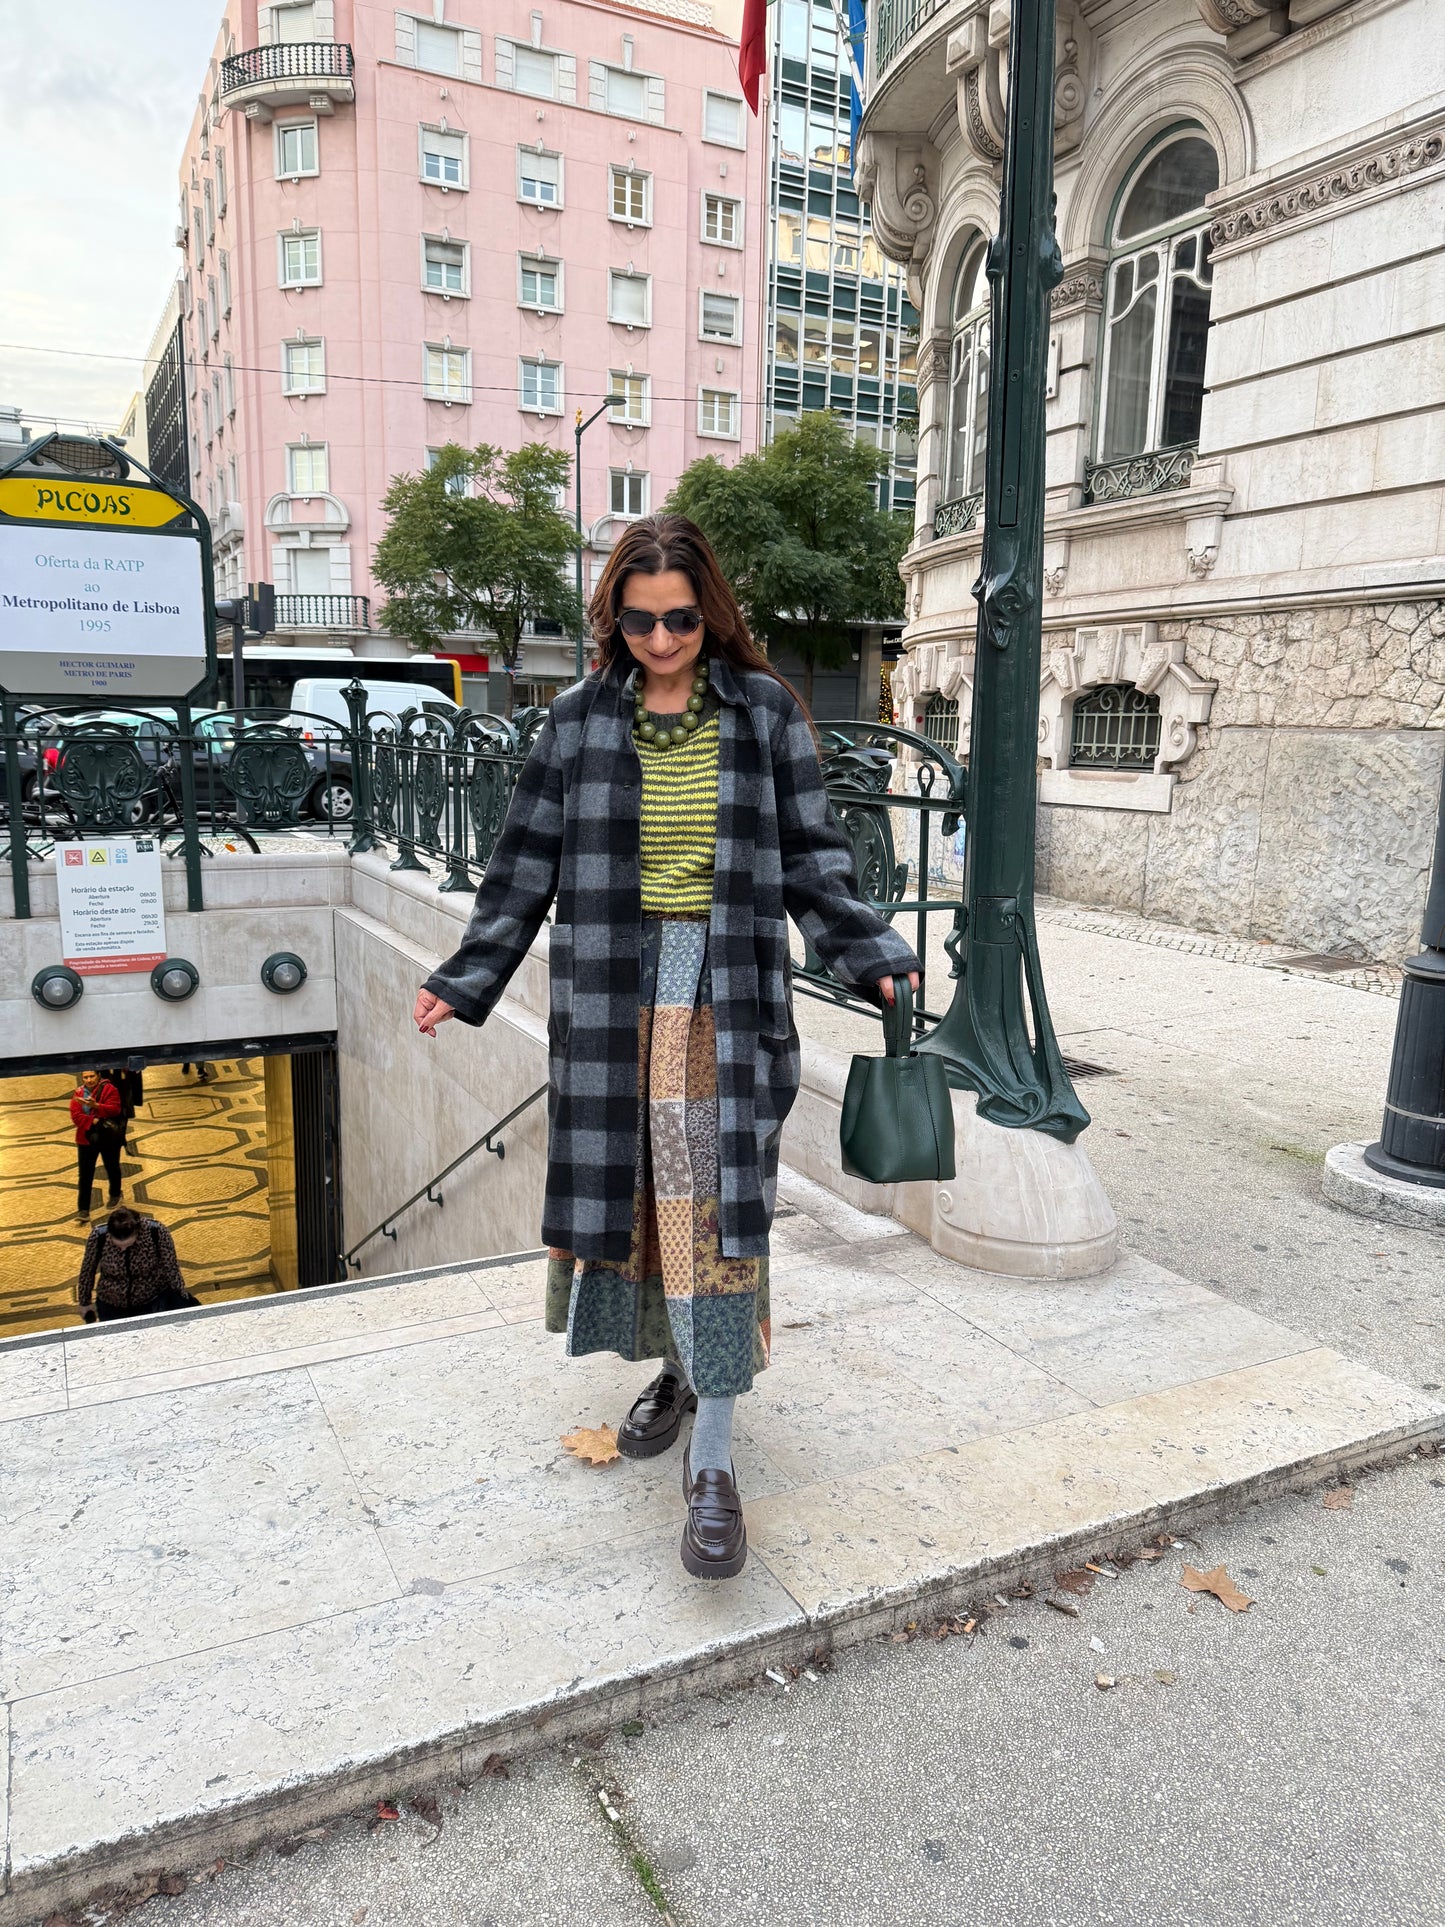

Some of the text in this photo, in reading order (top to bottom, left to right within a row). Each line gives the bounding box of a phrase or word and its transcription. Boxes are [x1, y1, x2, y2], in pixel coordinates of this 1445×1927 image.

[36, 488, 131, 516] PICOAS
[34, 554, 145, 572] Oferta da RATP
[84, 582, 101, 593] ao
[2, 595, 181, 615] Metropolitano de Lisboa
[79, 619, 112, 632] 1995
[59, 660, 135, 669] HECTOR GUIMARD
[64, 670, 95, 678] METRO
[96, 670, 107, 678] DE
[108, 885, 134, 893] estação
[73, 908, 99, 916] Horário
